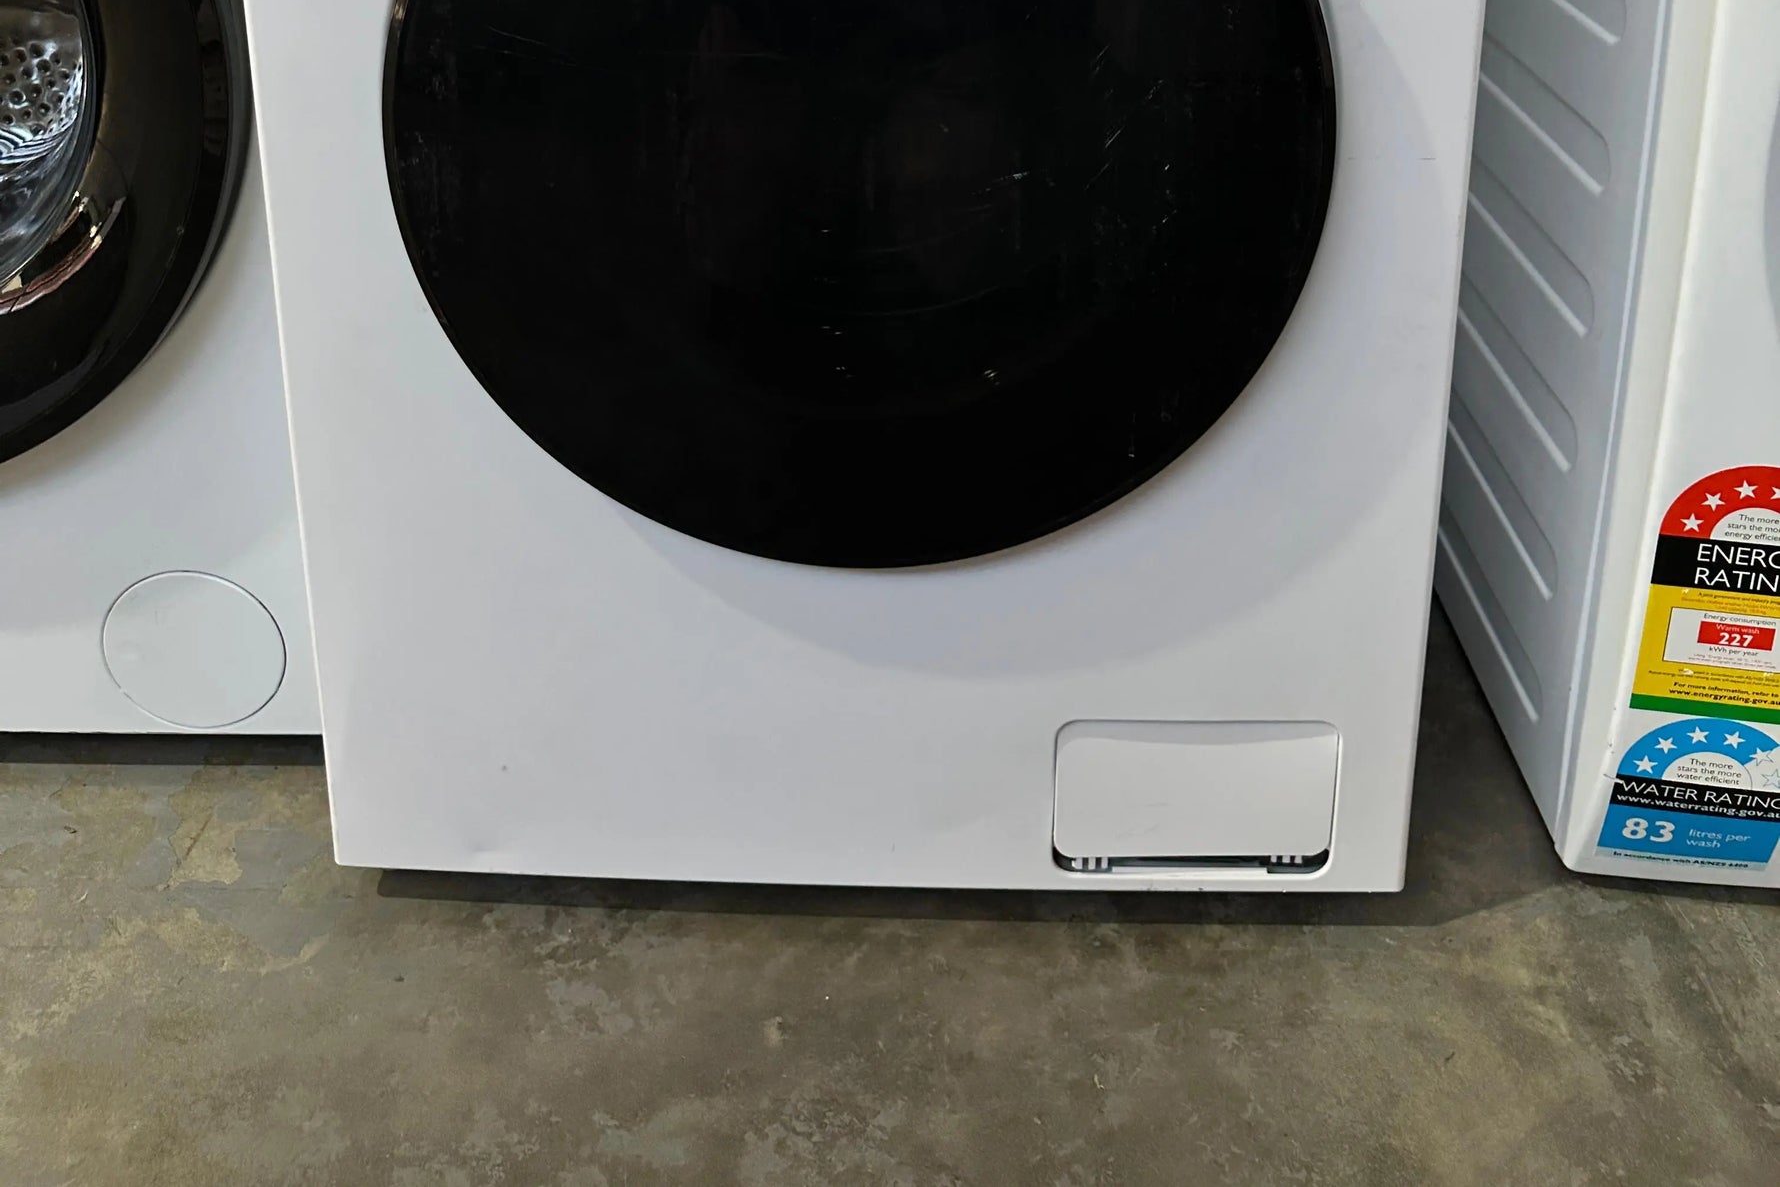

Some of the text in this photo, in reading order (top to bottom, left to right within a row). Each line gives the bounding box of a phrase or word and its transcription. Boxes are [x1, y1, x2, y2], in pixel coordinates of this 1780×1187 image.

[1739, 514, 1755, 522] The
[1725, 531, 1753, 540] energy
[1704, 613, 1777, 626] Energy consumption
[1716, 623, 1740, 632] Warm
[1719, 632, 1754, 647] 227
[1709, 645, 1727, 653] kWh
[1752, 689, 1769, 697] refer
[1690, 758, 1733, 770] The more
[1677, 765, 1742, 778] stars the more
[1677, 773, 1740, 786] water efficient
[1619, 780, 1698, 801] WATER
[1621, 817, 1676, 843] 83
[1689, 828, 1751, 842] litres per
[1686, 838, 1721, 849] wash
[1623, 852, 1671, 862] accordance
